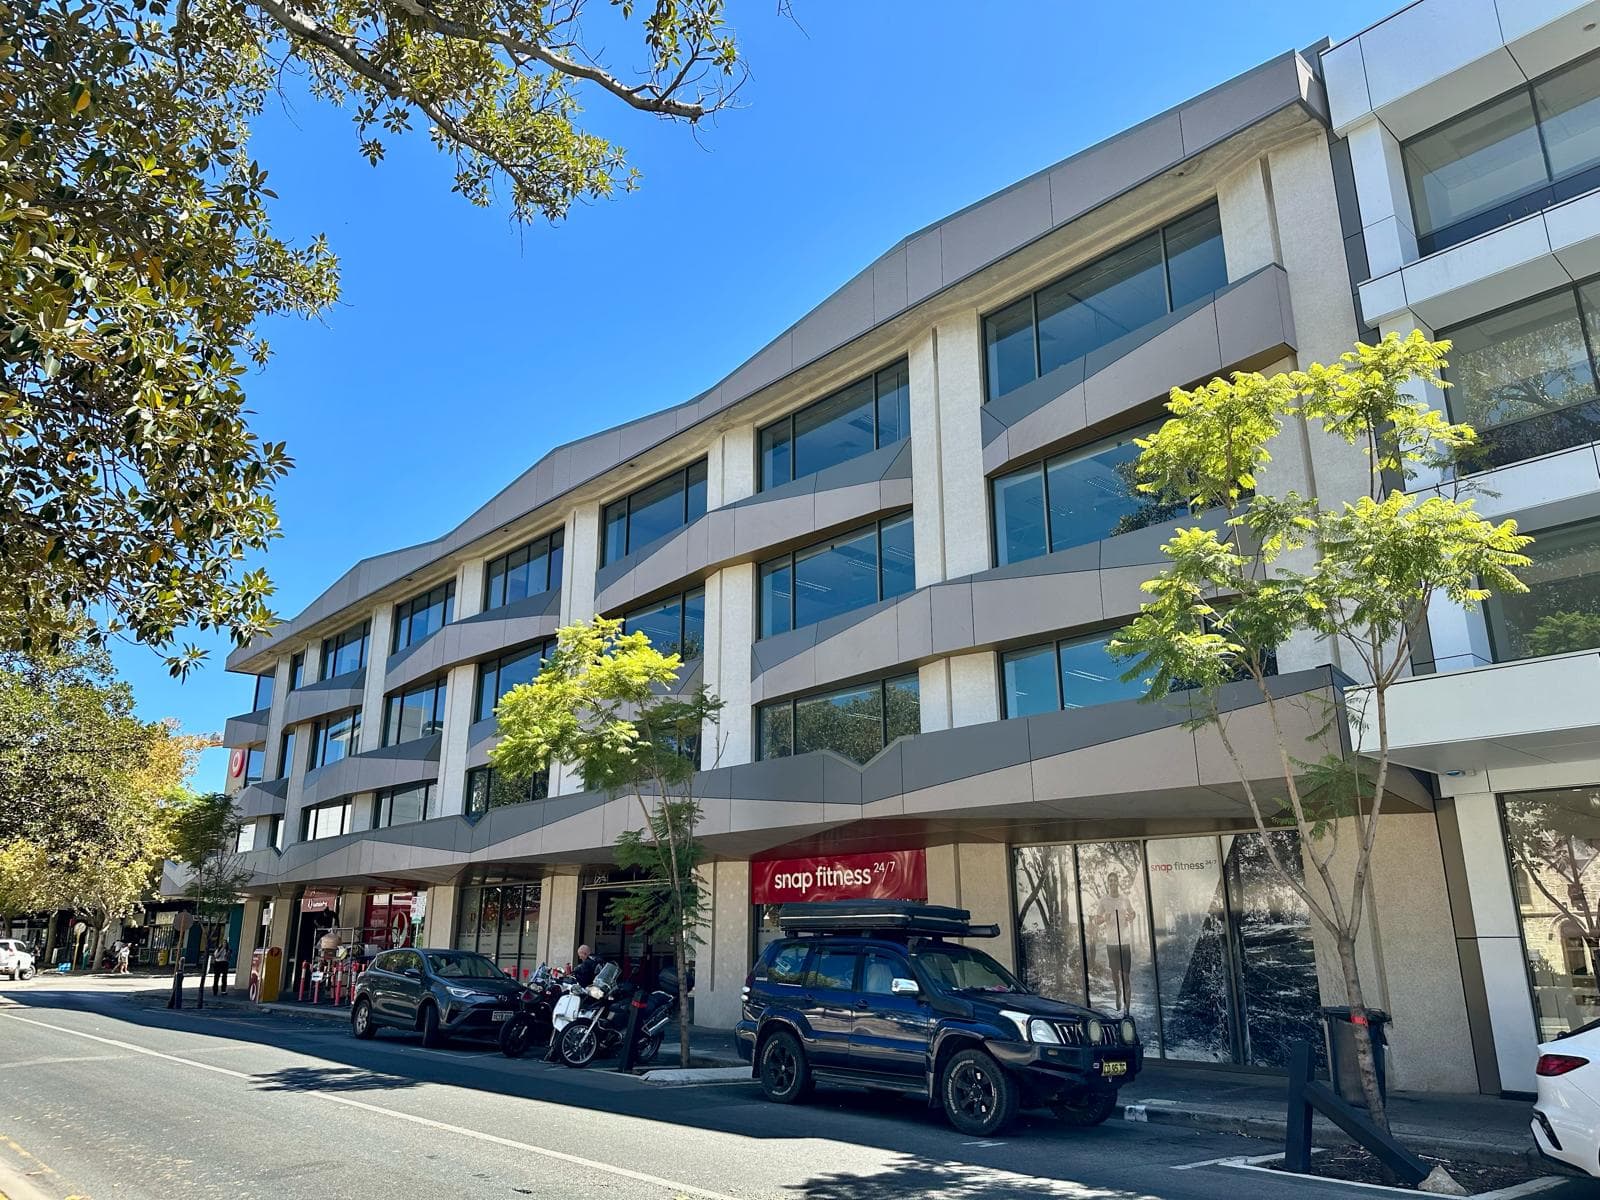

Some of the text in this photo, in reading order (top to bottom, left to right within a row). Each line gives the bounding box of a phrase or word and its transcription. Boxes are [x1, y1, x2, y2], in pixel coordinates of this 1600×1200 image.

[774, 861, 896, 894] snap fitness 24/7
[1151, 864, 1172, 873] snap
[1174, 861, 1205, 871] fitness
